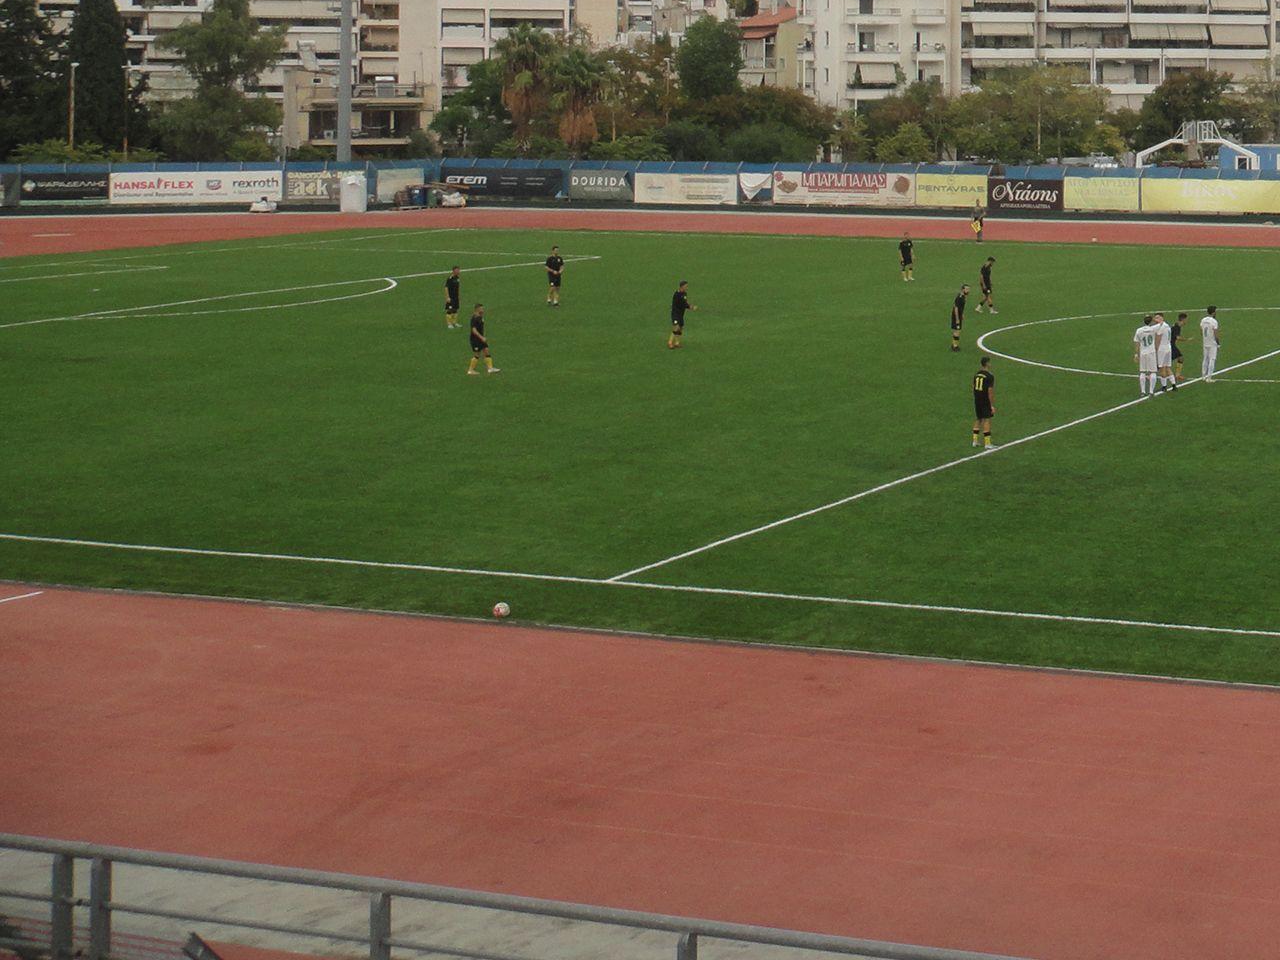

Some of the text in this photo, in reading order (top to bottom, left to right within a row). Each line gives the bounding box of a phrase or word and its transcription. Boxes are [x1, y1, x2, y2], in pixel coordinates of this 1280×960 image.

[113, 180, 155, 190] HANSA
[163, 180, 195, 190] FLEX
[232, 177, 279, 188] rexroth
[571, 176, 626, 187] DOURIDA
[802, 172, 886, 188] ΜΠΑΡΜΠΑΛΙΑΣ
[917, 184, 986, 193] PENTAVRAS
[991, 181, 1059, 203] Ντάσης
[975, 377, 983, 391] 11
